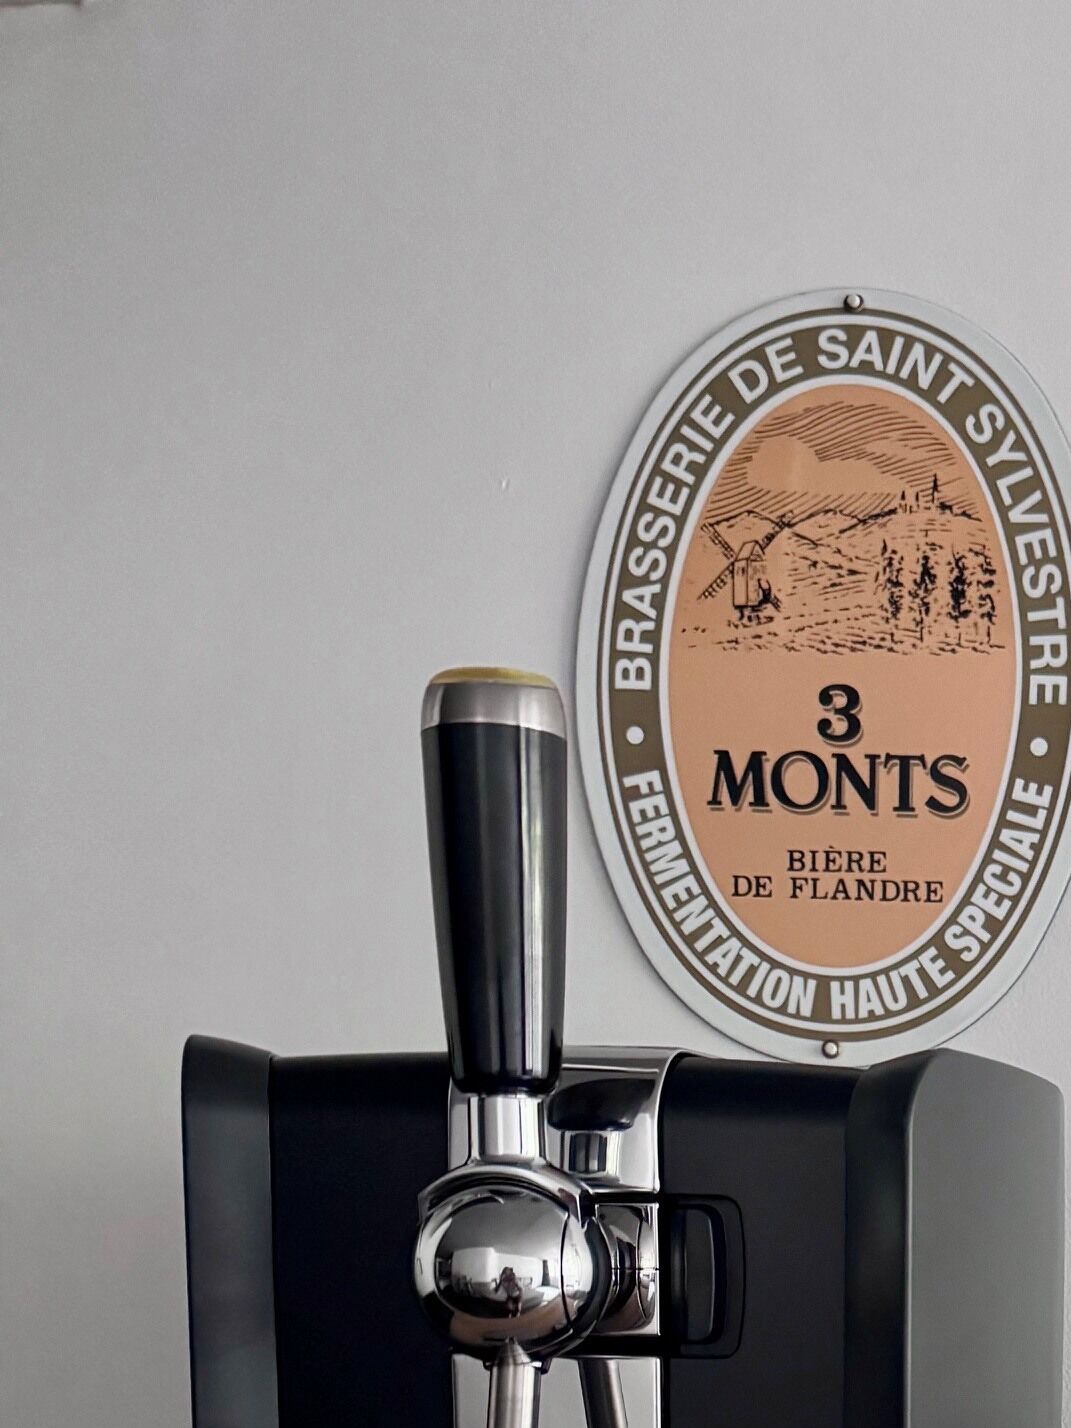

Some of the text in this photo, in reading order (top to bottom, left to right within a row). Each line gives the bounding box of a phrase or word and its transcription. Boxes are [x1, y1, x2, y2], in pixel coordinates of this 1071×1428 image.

[614, 328, 1069, 706] BRASSERIE DE SAINT SYLVESTRE
[816, 684, 862, 745] 3
[706, 750, 971, 816] MONTS
[731, 875, 944, 904] DE FLANDRE
[786, 845, 888, 874] BIÈRE
[623, 769, 1054, 1021] FERMENTATION HAUTE SPECIALE
